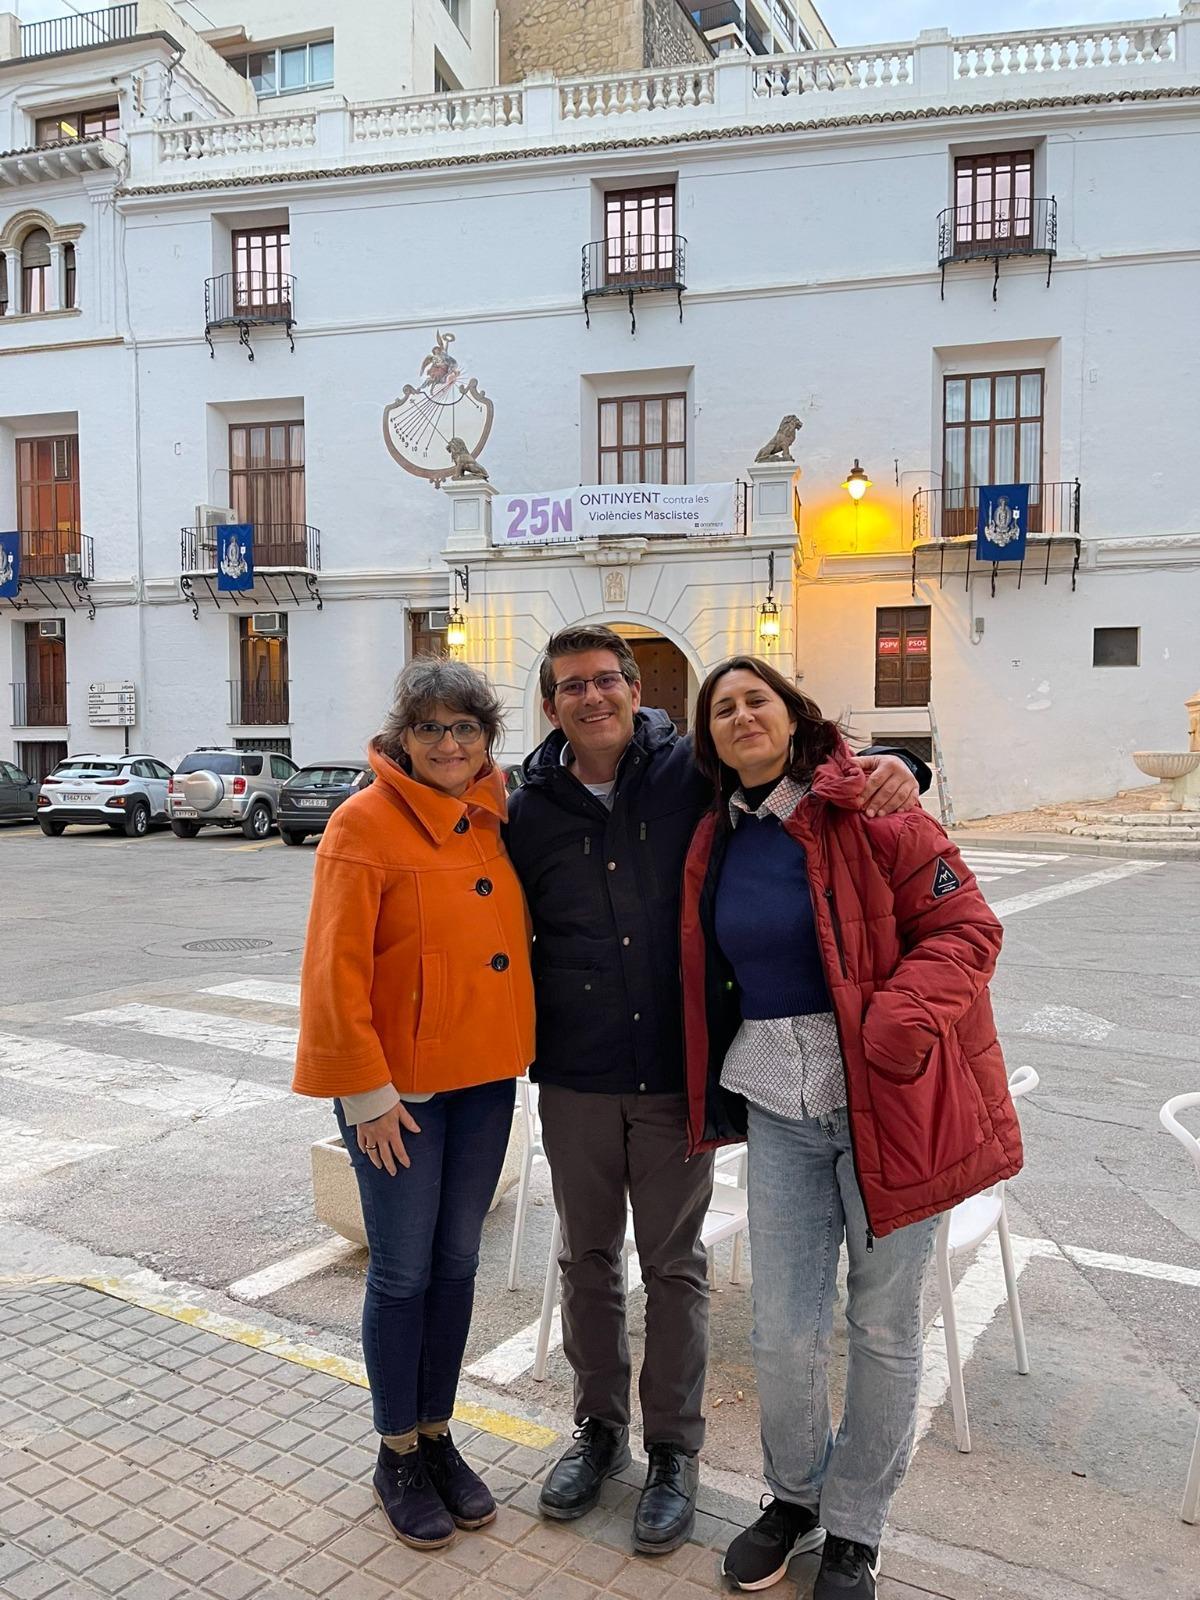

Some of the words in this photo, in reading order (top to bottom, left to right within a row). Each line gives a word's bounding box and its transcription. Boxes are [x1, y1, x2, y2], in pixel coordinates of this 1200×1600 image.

[580, 492, 660, 505] ONTINYENT
[663, 496, 693, 504] contra
[695, 495, 709, 503] les
[507, 497, 573, 538] 25N
[589, 510, 642, 521] Violències
[644, 510, 700, 520] Masclistes
[880, 641, 898, 649] PSPV
